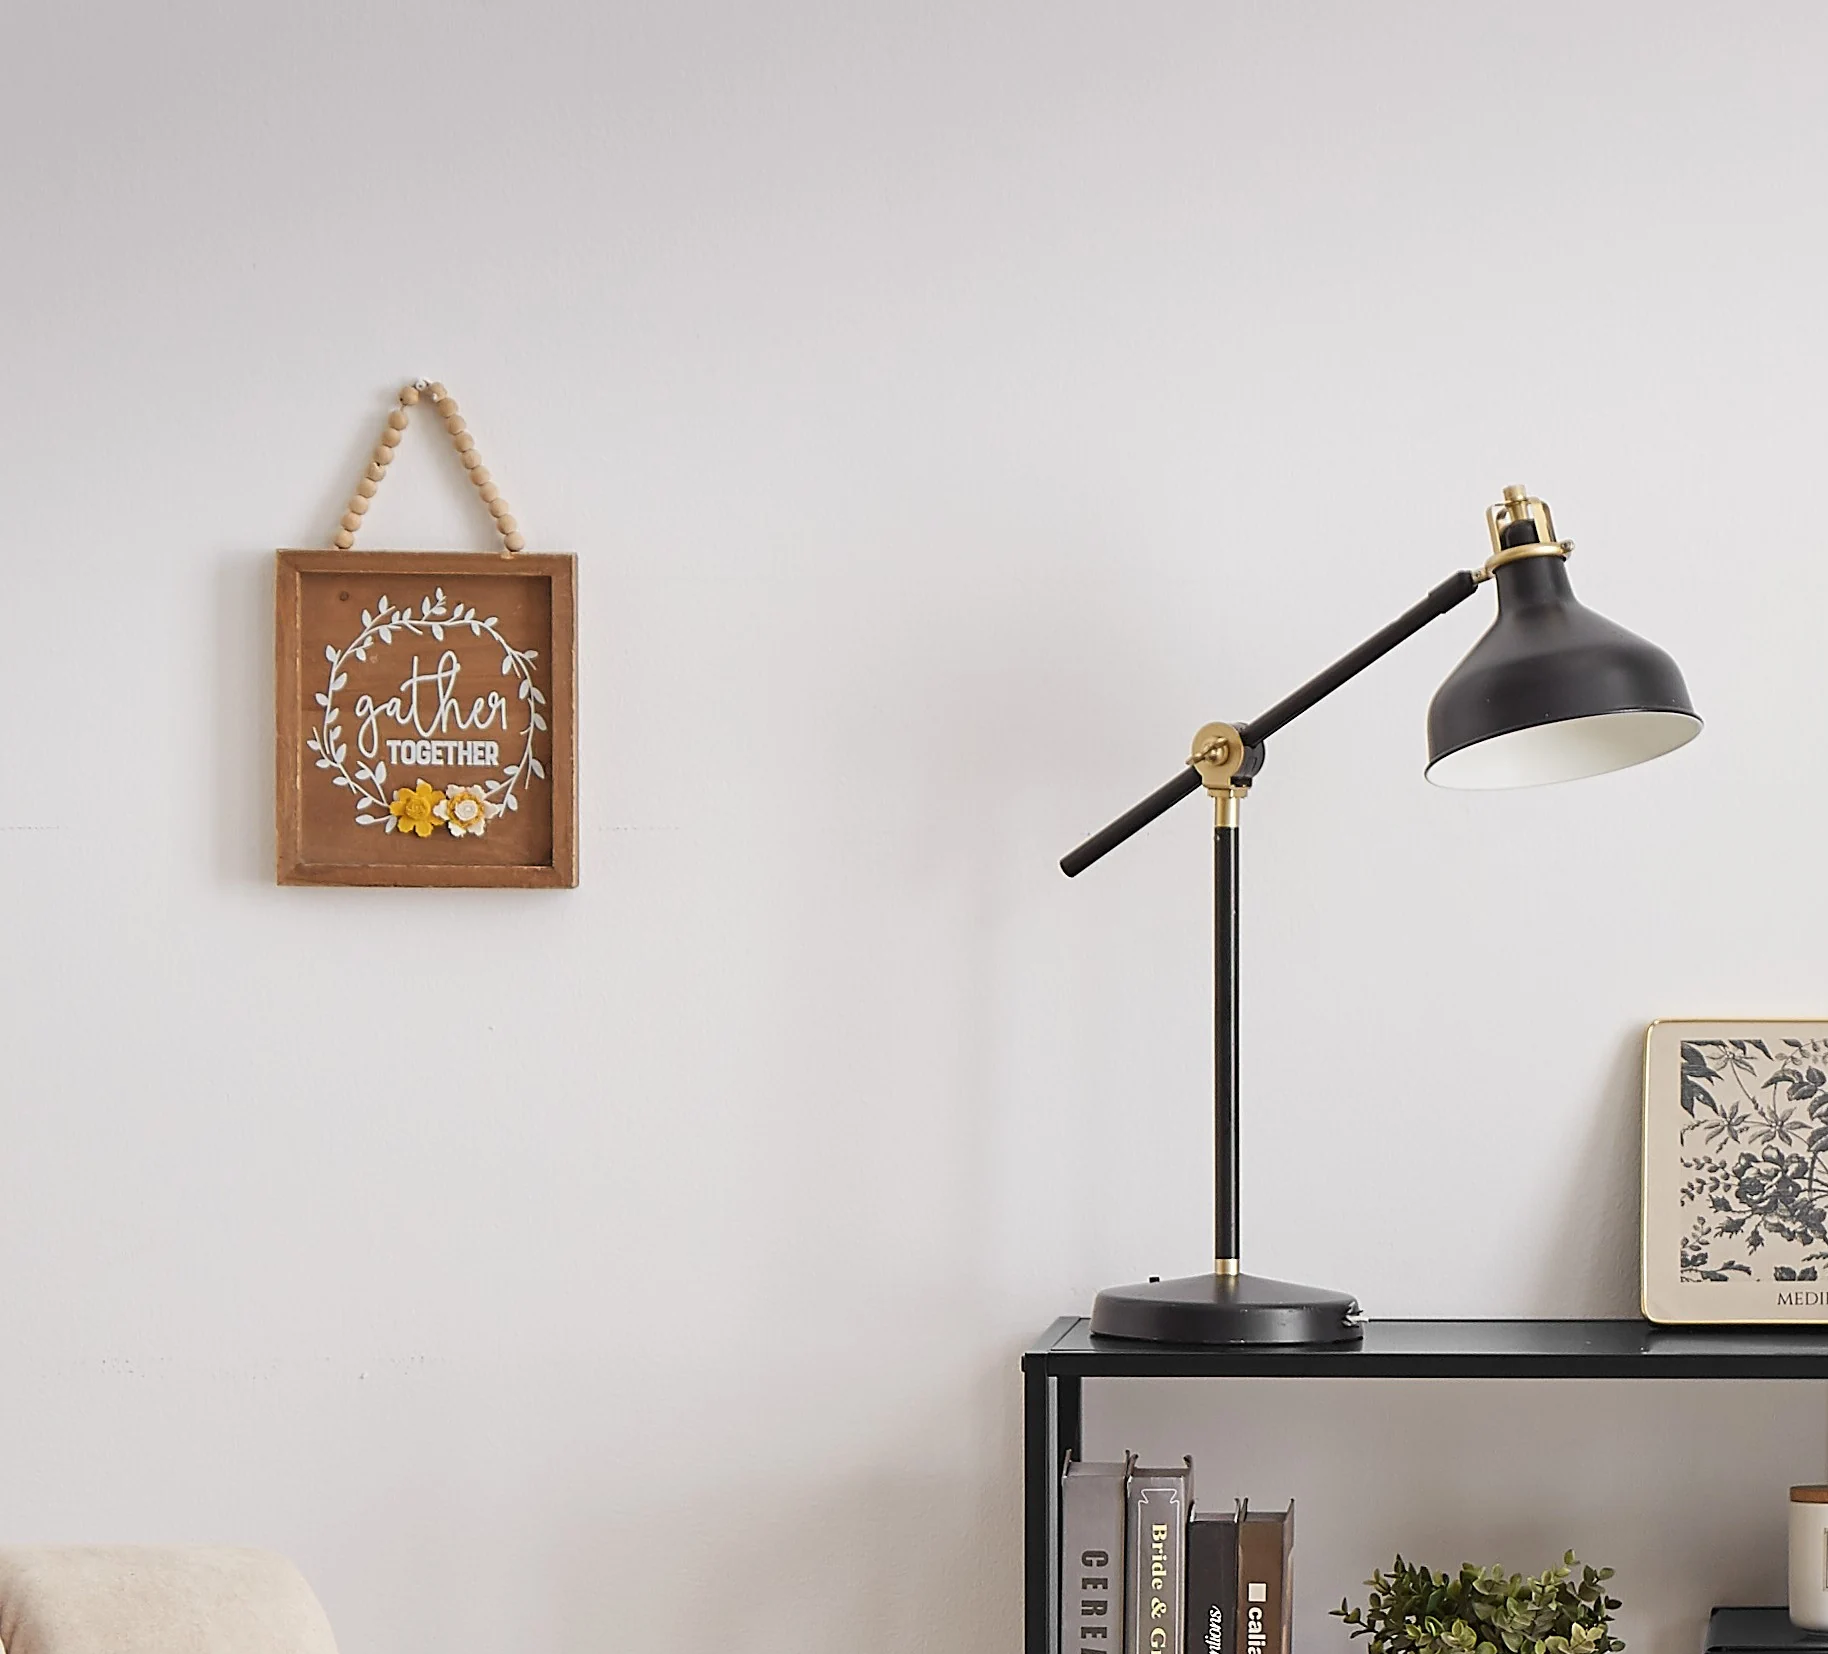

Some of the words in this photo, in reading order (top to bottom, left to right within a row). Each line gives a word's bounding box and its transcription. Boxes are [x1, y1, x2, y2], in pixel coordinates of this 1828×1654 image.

[355, 650, 508, 758] gather
[386, 740, 499, 766] TOGETHER
[1151, 1523, 1168, 1590] Bride
[1151, 1597, 1167, 1619] &
